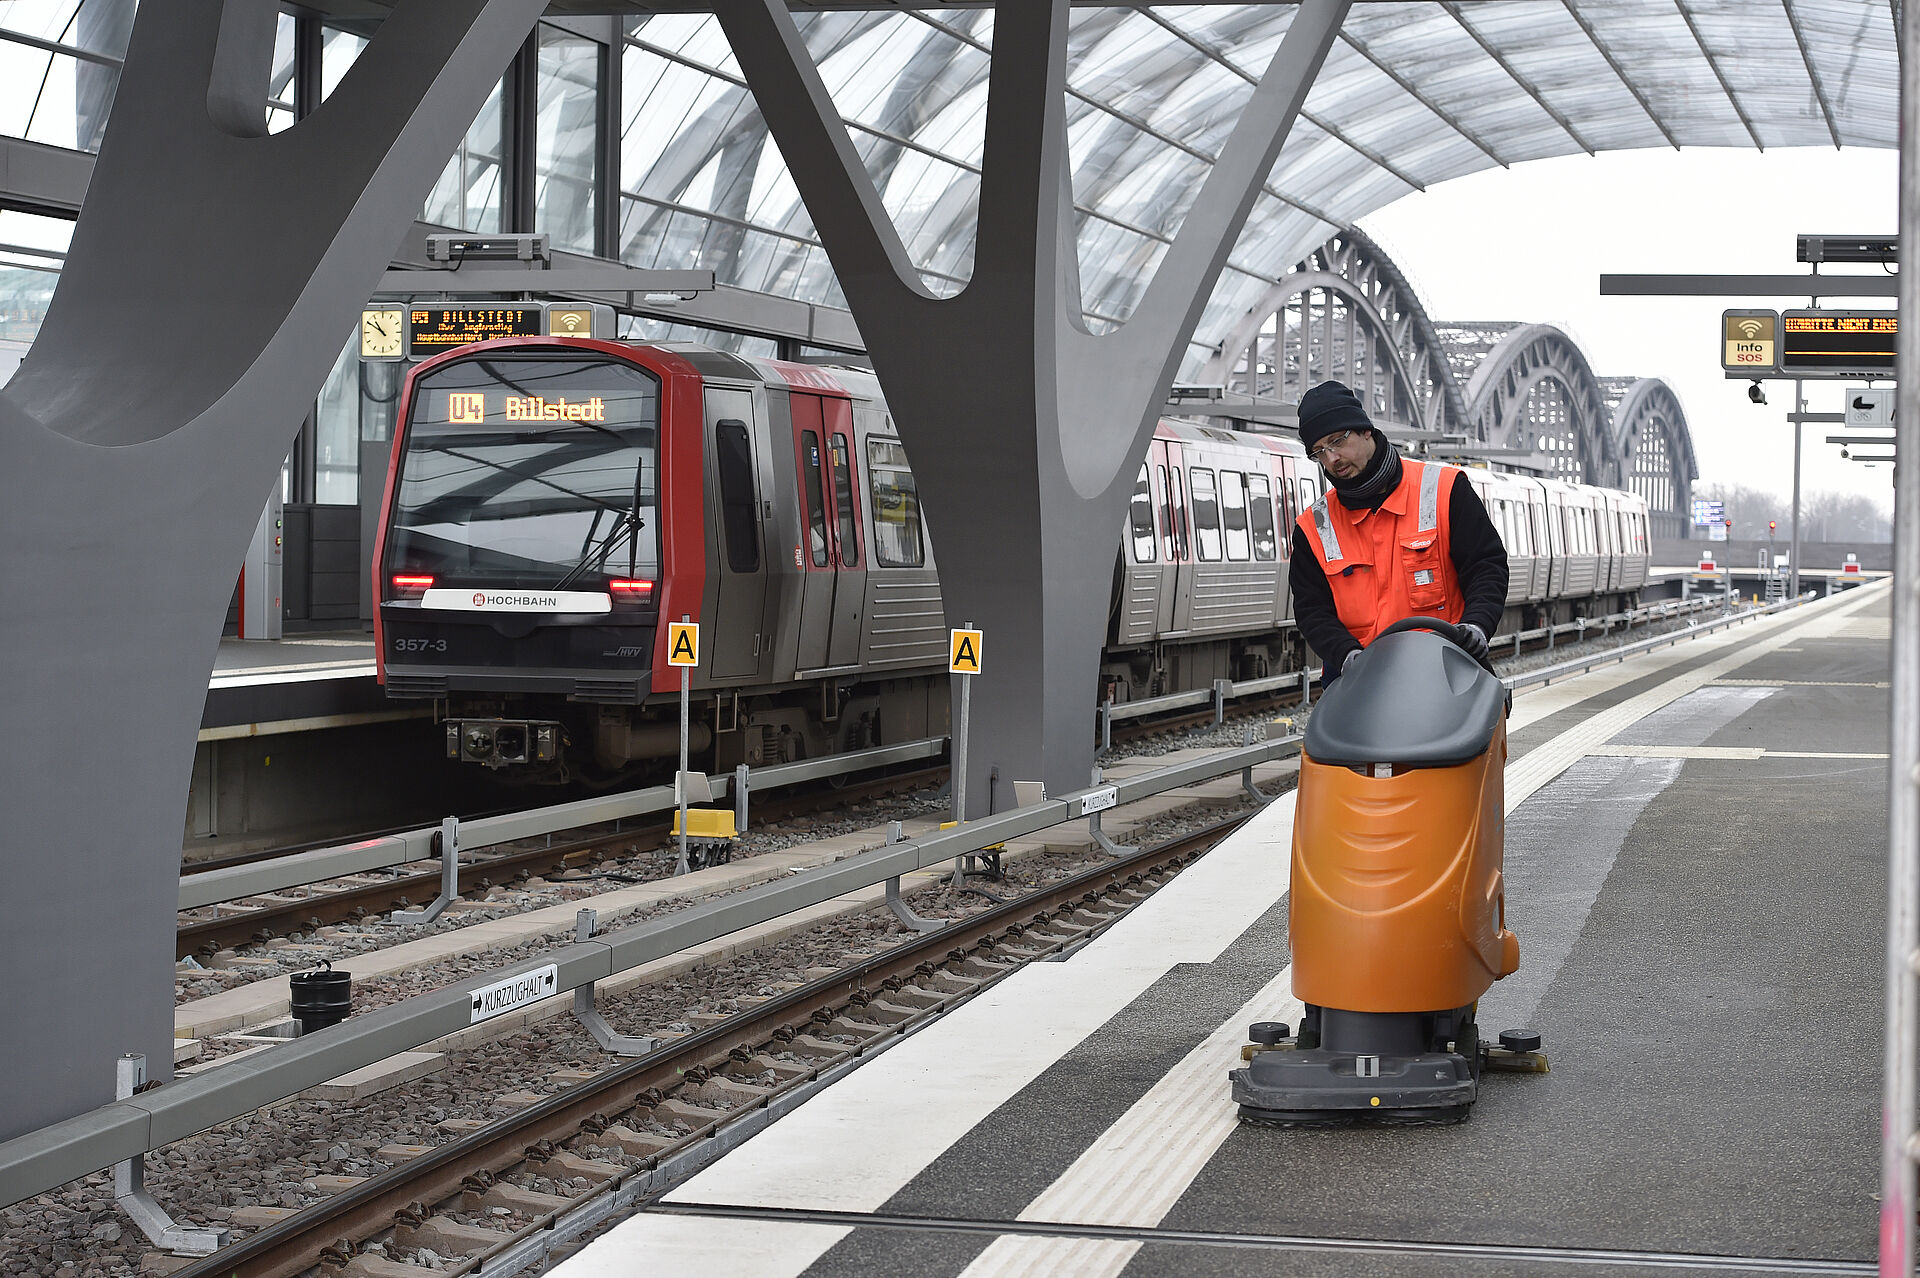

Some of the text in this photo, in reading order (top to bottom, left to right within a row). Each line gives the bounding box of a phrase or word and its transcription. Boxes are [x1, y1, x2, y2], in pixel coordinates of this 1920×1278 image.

[442, 310, 523, 323] BILLSTEDT
[1804, 318, 1835, 330] BITTE
[1837, 318, 1870, 330] NICHT
[1737, 342, 1763, 352] Info
[1737, 353, 1763, 363] SOS
[452, 395, 606, 421] U4 Billstedt
[487, 595, 556, 607] HOCHBAHN
[394, 638, 448, 652] 357-3
[671, 629, 695, 660] A
[953, 636, 978, 668] A
[484, 975, 543, 1014] KURZZUGHALT
